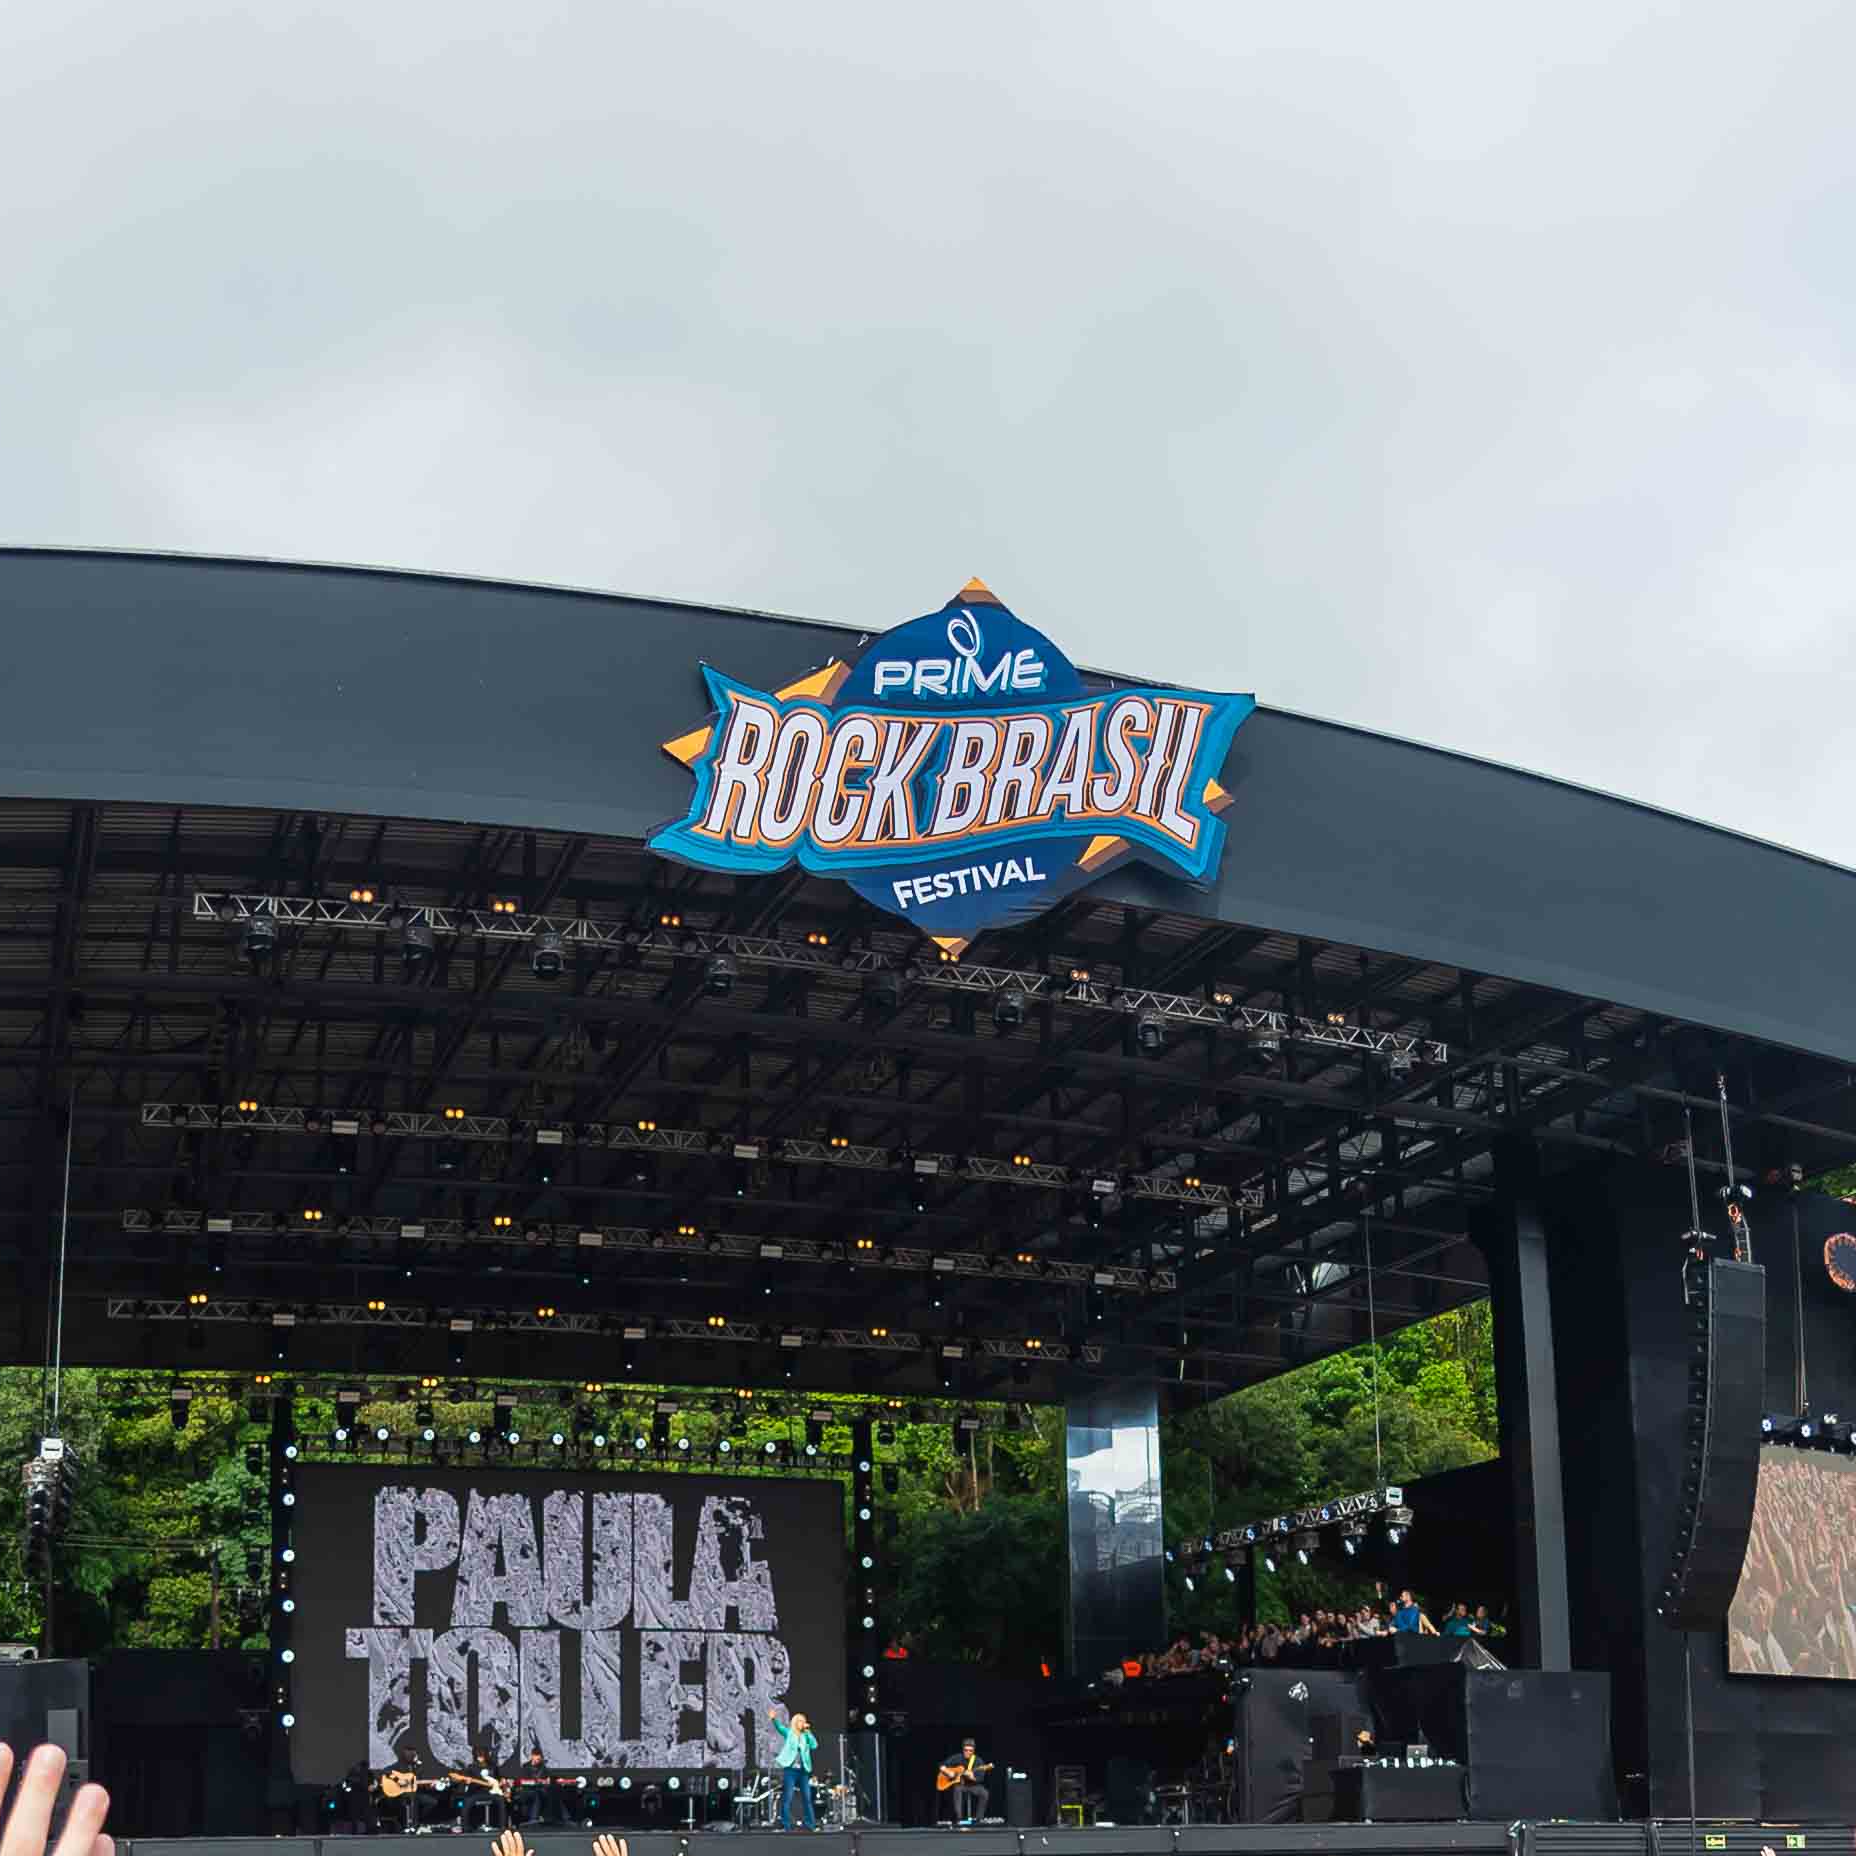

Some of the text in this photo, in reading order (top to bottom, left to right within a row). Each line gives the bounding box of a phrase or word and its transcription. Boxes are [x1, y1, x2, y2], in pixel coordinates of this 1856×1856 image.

[873, 648, 1045, 696] PRIME
[705, 694, 1209, 846] ROCK BRASIL
[892, 856, 1047, 909] FESTIVAL
[373, 1484, 777, 1630] PAULA
[345, 1626, 792, 1770] TOLLER
